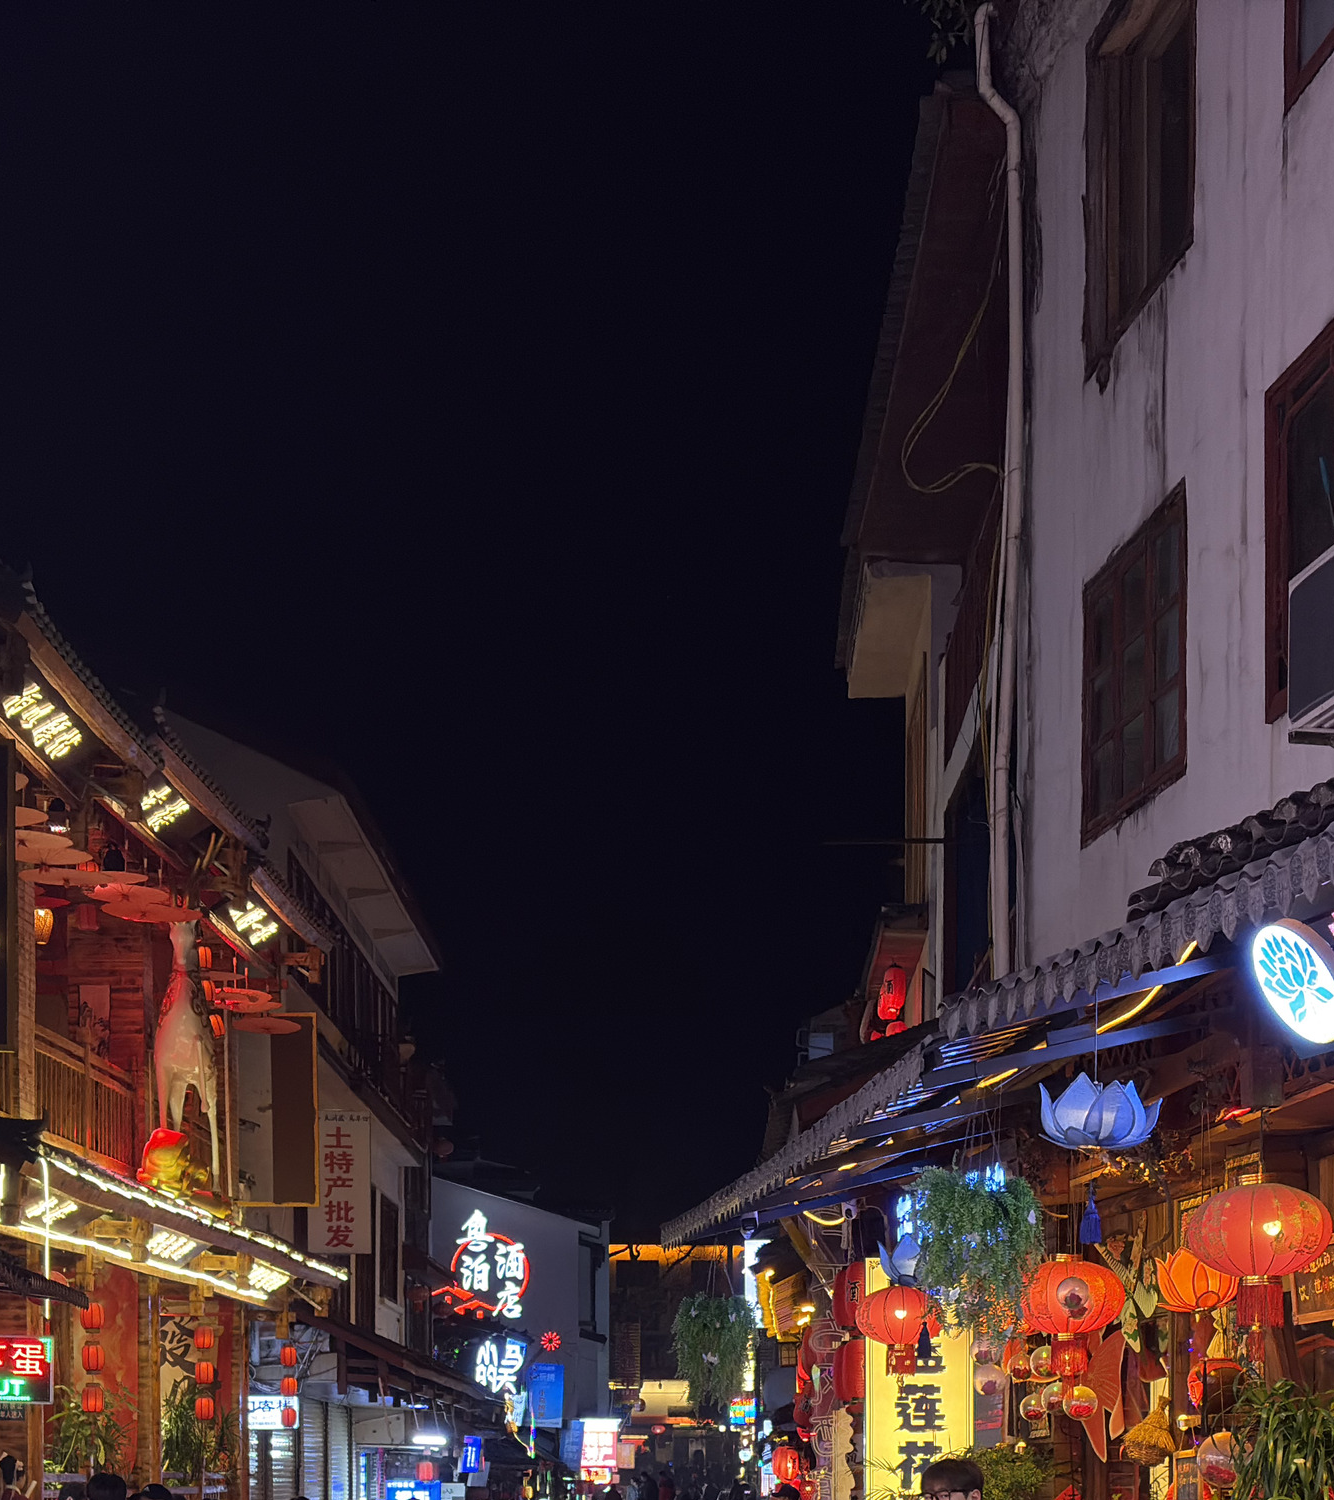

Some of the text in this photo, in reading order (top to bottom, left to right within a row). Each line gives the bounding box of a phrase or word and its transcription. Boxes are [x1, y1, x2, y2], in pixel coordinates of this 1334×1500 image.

[324, 1126, 354, 1248] 土特产批发
[492, 1242, 527, 1319] 酒店
